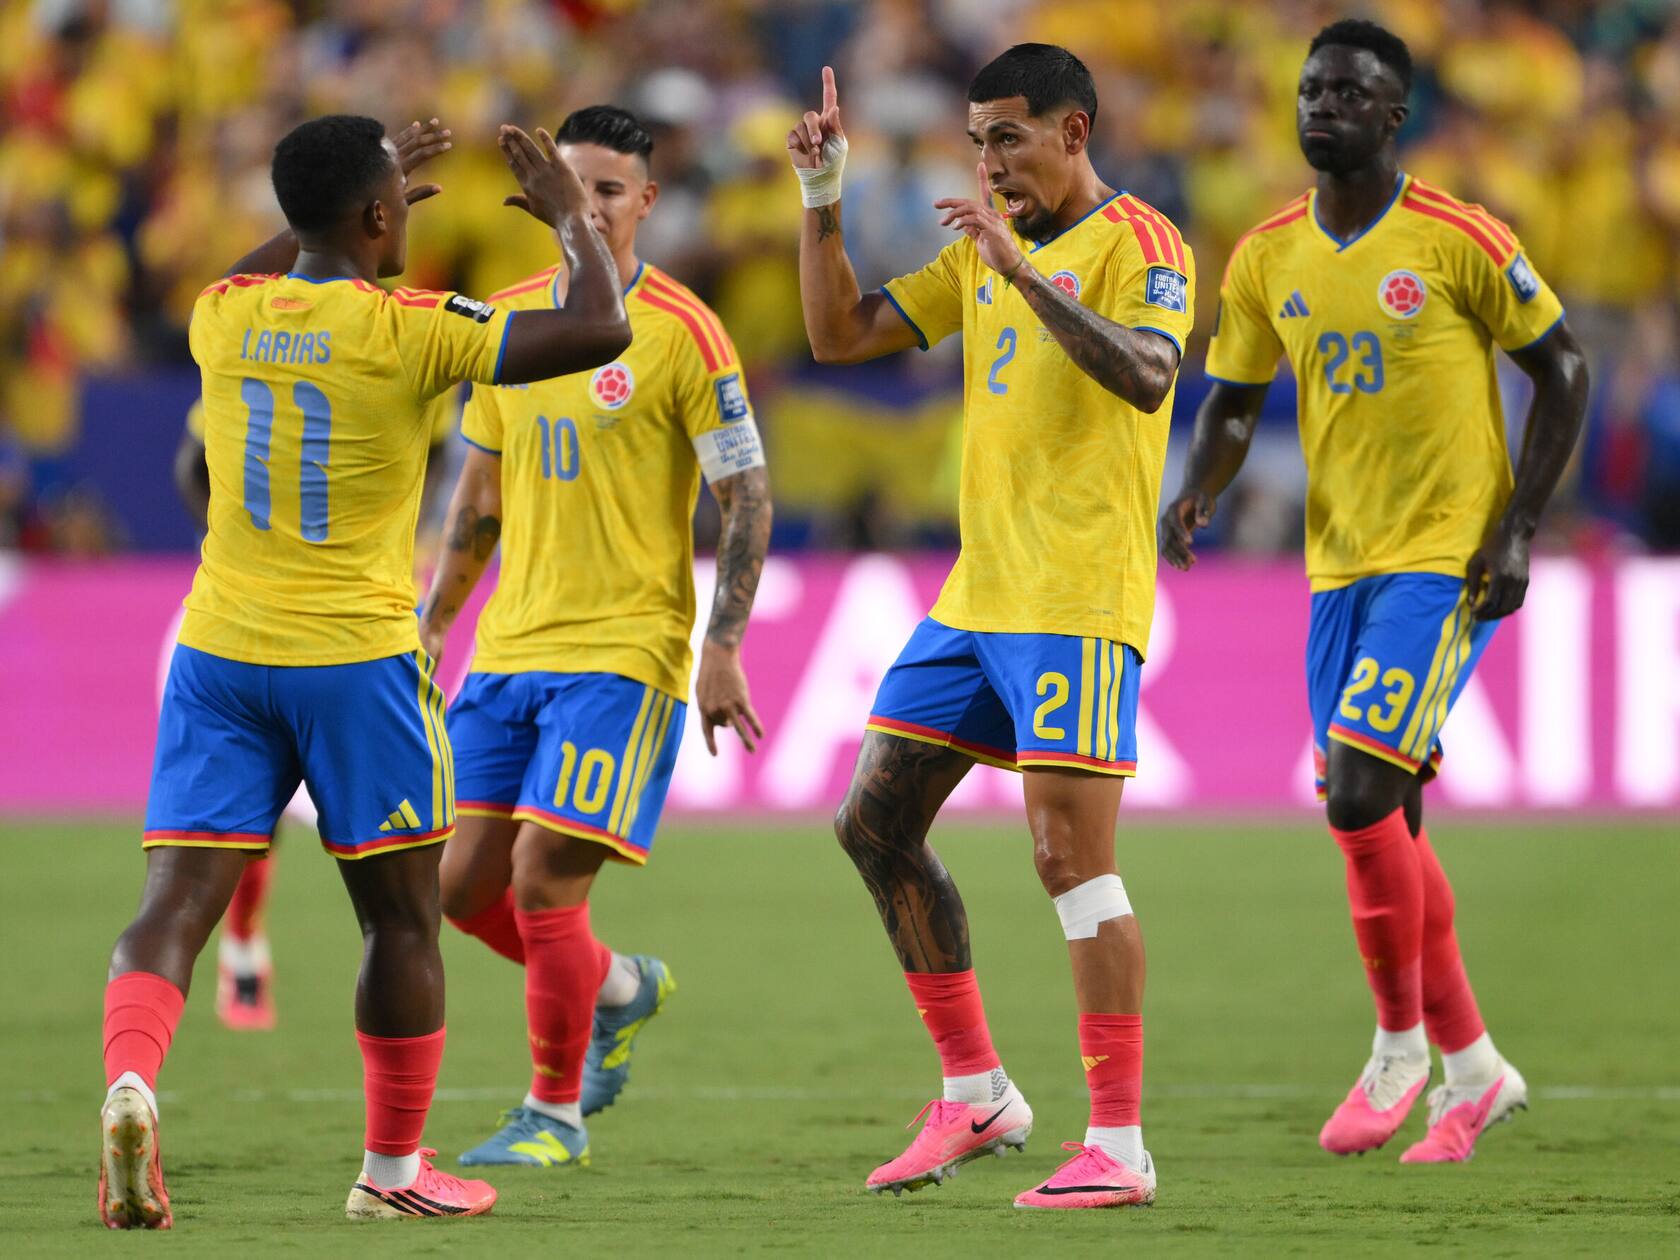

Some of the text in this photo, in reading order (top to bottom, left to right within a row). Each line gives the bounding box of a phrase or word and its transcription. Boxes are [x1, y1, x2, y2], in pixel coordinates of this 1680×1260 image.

[240, 328, 331, 364] J.ARIAS
[988, 327, 1017, 395] 2
[1317, 330, 1384, 394] 23
[240, 376, 332, 543] 11
[536, 415, 581, 482] 10
[1033, 671, 1070, 740] 2
[1340, 657, 1415, 733] 23
[553, 741, 615, 815] 10
